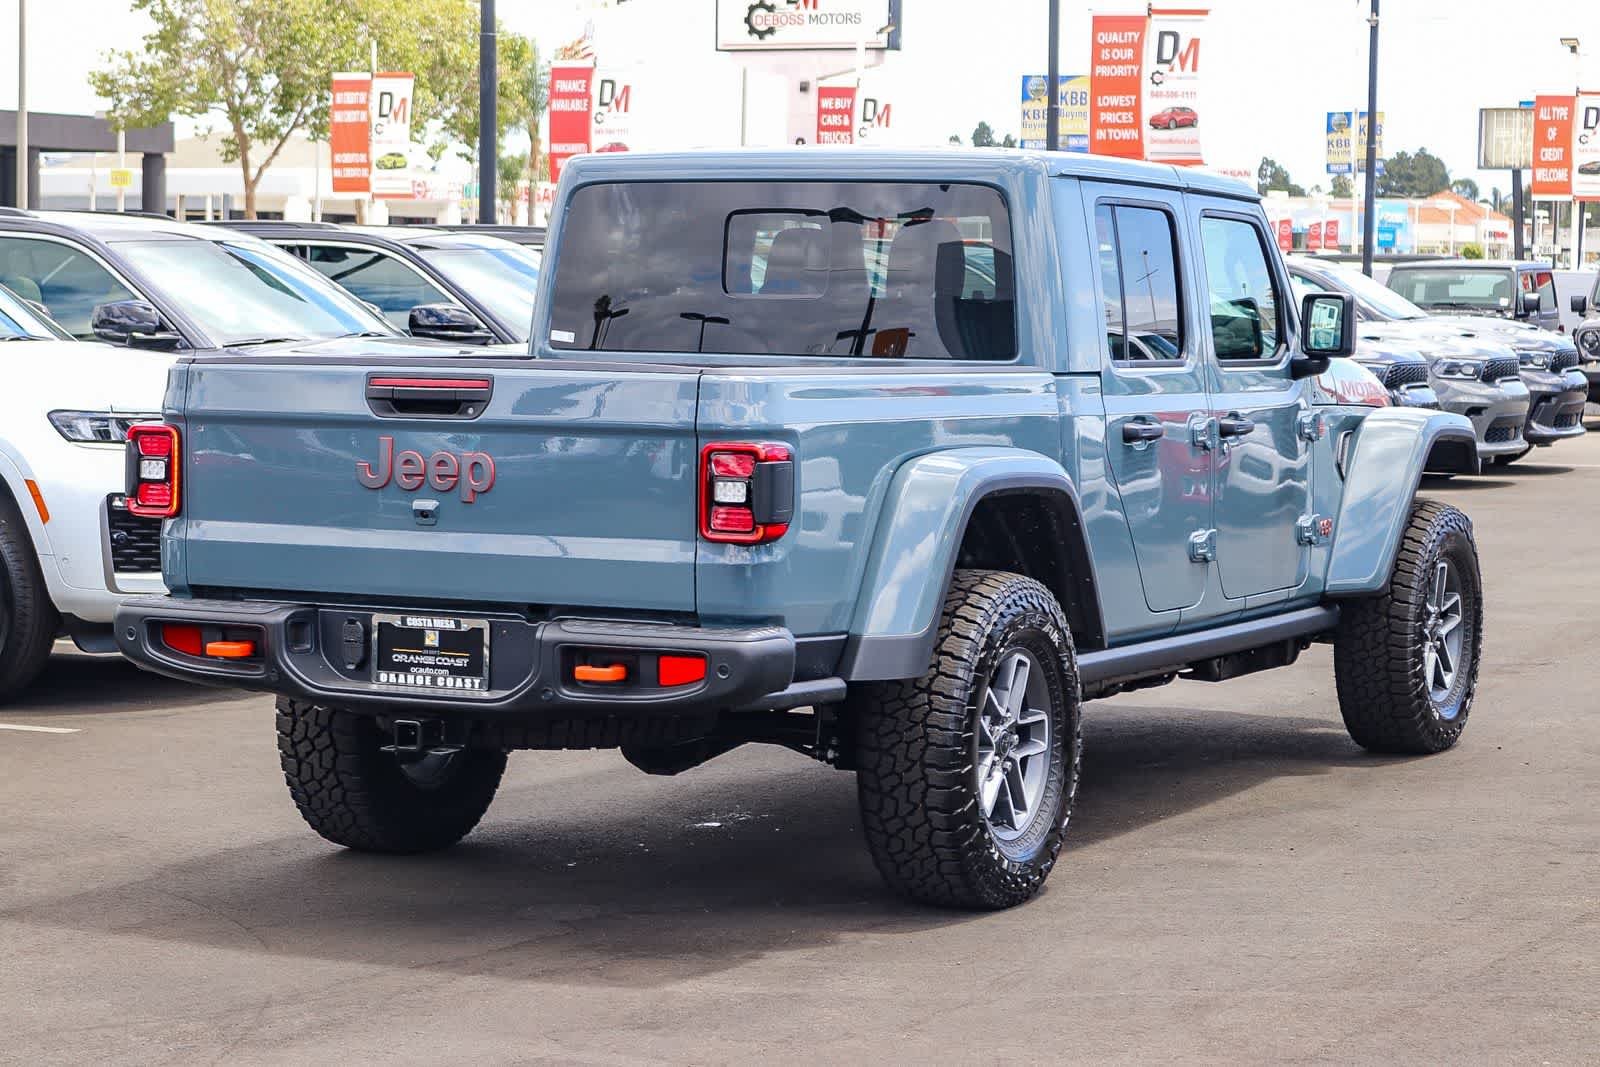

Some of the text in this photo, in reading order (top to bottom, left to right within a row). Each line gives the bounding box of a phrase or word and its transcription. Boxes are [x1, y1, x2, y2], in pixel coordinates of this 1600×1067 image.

[754, 13, 862, 26] DEBOSS MOTORS
[1097, 31, 1141, 44] QUALITY
[1101, 48, 1135, 60] IS OUR
[1095, 65, 1140, 77] PRIORITY
[555, 79, 587, 93] FINANCE
[550, 98, 589, 112] AVAILABLE
[821, 97, 852, 109] WE BUY
[1060, 91, 1088, 106] KBB
[1097, 95, 1137, 107] LOWEST
[1056, 110, 1088, 121] Buying
[1099, 111, 1134, 124] PRICES
[1539, 106, 1569, 120] ALL TYPE
[822, 114, 850, 126] CARS &
[1096, 129, 1107, 140] IN
[1107, 128, 1139, 141] TOWN
[1547, 127, 1557, 140] OF
[1327, 138, 1350, 149] KBB
[1540, 147, 1564, 161] CREDIT
[1535, 168, 1568, 182] WELCOME
[356, 436, 496, 503] Jeep
[406, 617, 456, 629] COSTA MESA
[391, 653, 470, 667] ORANGE COAST
[410, 666, 449, 676] ocauto.com
[380, 673, 481, 689] ORANGE COAST
